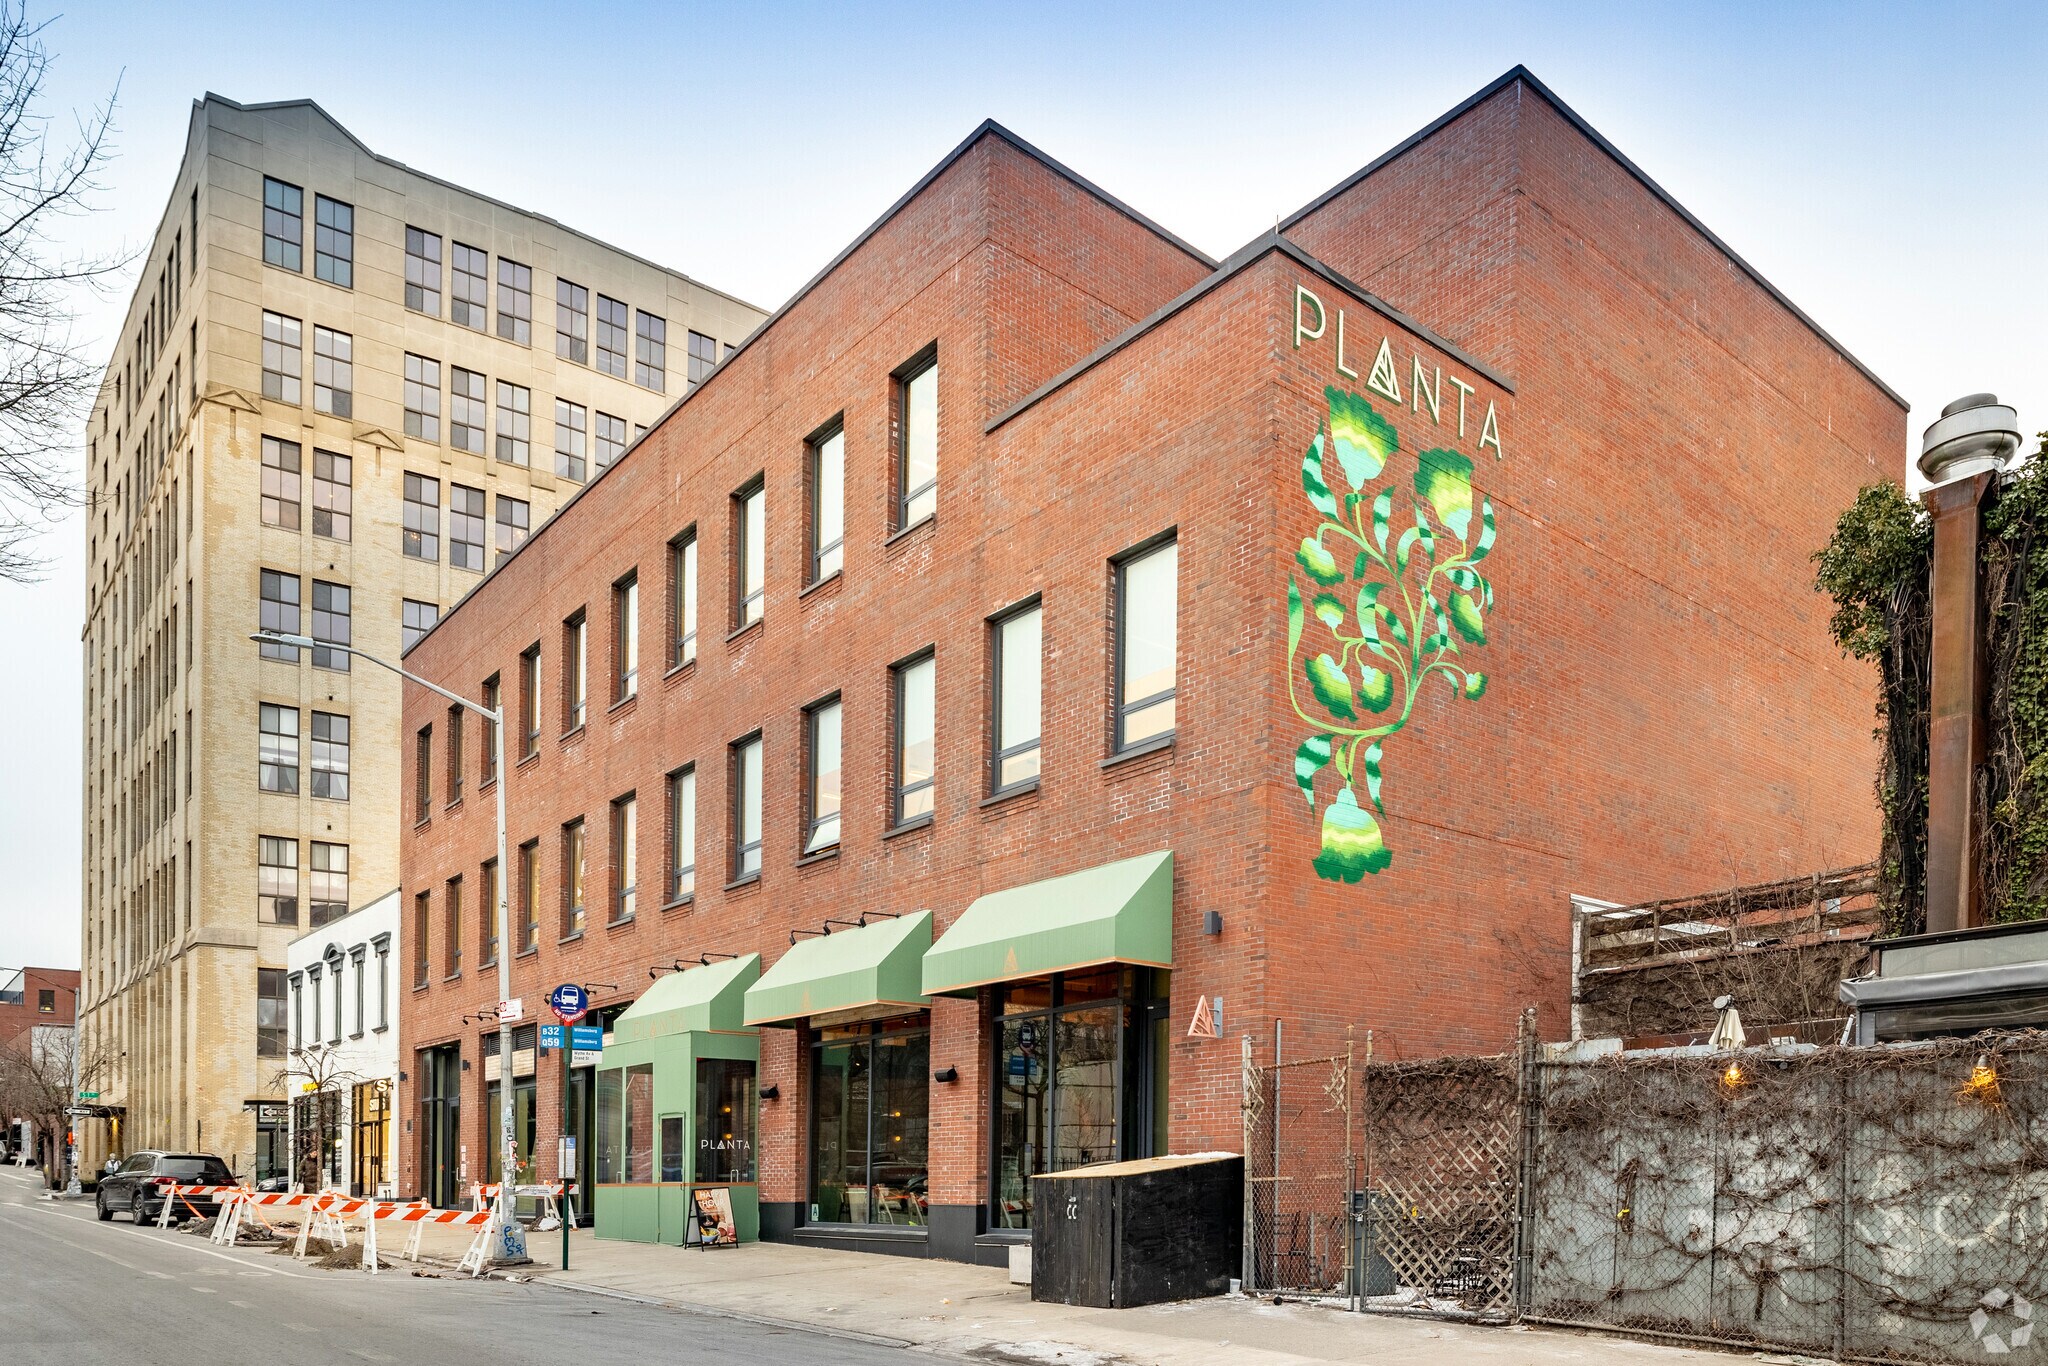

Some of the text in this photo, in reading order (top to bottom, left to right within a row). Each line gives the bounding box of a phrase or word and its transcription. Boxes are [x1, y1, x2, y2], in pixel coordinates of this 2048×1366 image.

[1293, 284, 1503, 461] PLANTA
[561, 1010, 585, 1020] STANDING
[542, 1026, 560, 1036] B32
[542, 1037, 560, 1047] Q59
[701, 1139, 751, 1150] PLANTA
[812, 1206, 818, 1216] A
